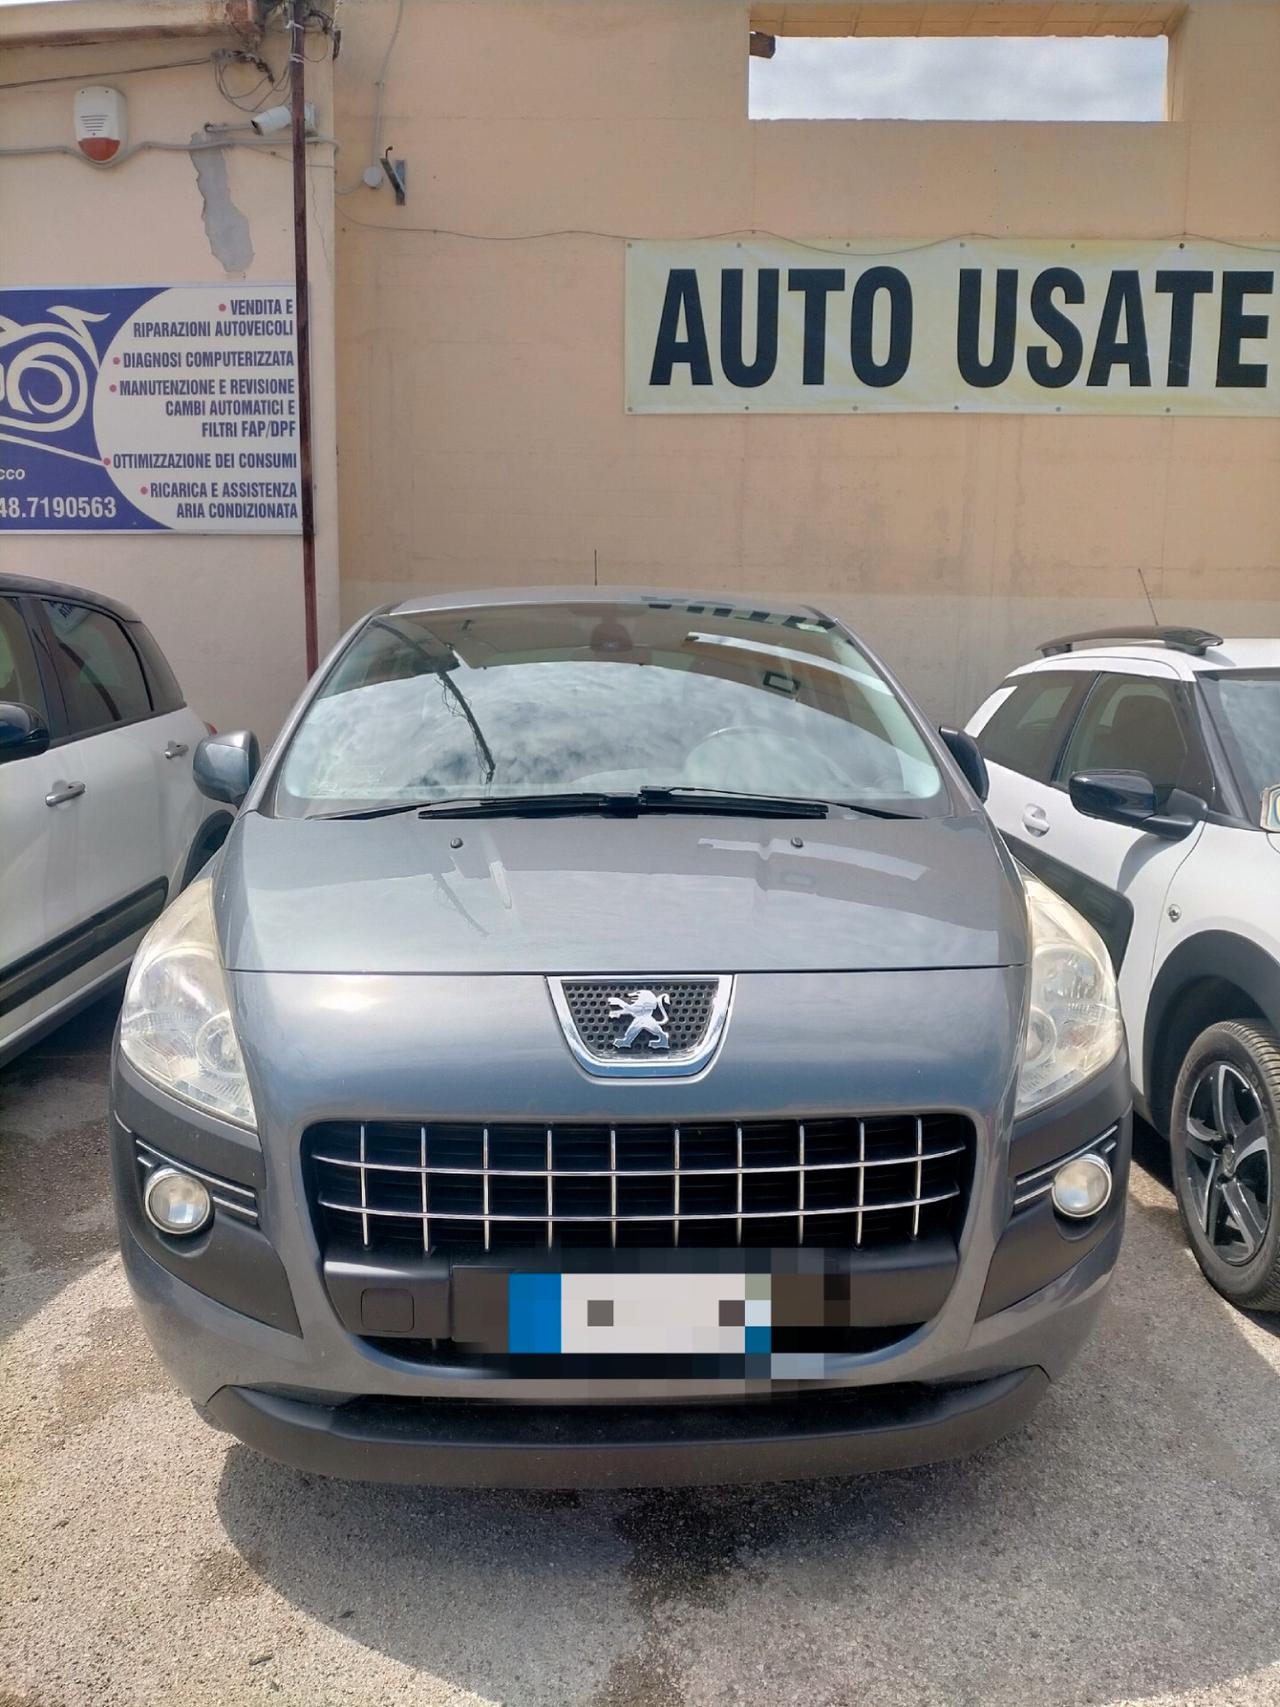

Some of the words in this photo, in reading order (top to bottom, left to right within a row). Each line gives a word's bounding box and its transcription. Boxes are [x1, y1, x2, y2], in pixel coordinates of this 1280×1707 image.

[231, 299, 282, 315] VENDITA
[286, 299, 293, 315] E
[133, 321, 211, 337] RIPARAZIONI
[215, 320, 293, 336] AUTOVEICOLI
[649, 265, 913, 388] AUTO
[956, 266, 1275, 389] USATE
[123, 352, 182, 368] DIAGNOSI
[186, 351, 294, 367] COMPUTERIZZATA
[120, 379, 215, 396] MANUTENZIONE
[219, 379, 226, 395] E
[230, 378, 295, 394] REVISIONE
[166, 401, 206, 416] CAMBI
[209, 400, 283, 416] AUTOMATICI
[288, 400, 295, 415] E
[202, 422, 237, 438] FILTRI
[242, 420, 296, 439] FAP/DPF
[113, 453, 211, 469] OTTIMIZZAZIONE
[215, 453, 235, 469] DEI
[239, 453, 297, 469] CONSUMI
[150, 482, 208, 498] RICARICA
[211, 482, 218, 498] E
[222, 482, 297, 498] ASSISTENZA
[177, 503, 206, 518] ARIA
[209, 503, 298, 518] CONDIZIONATA
